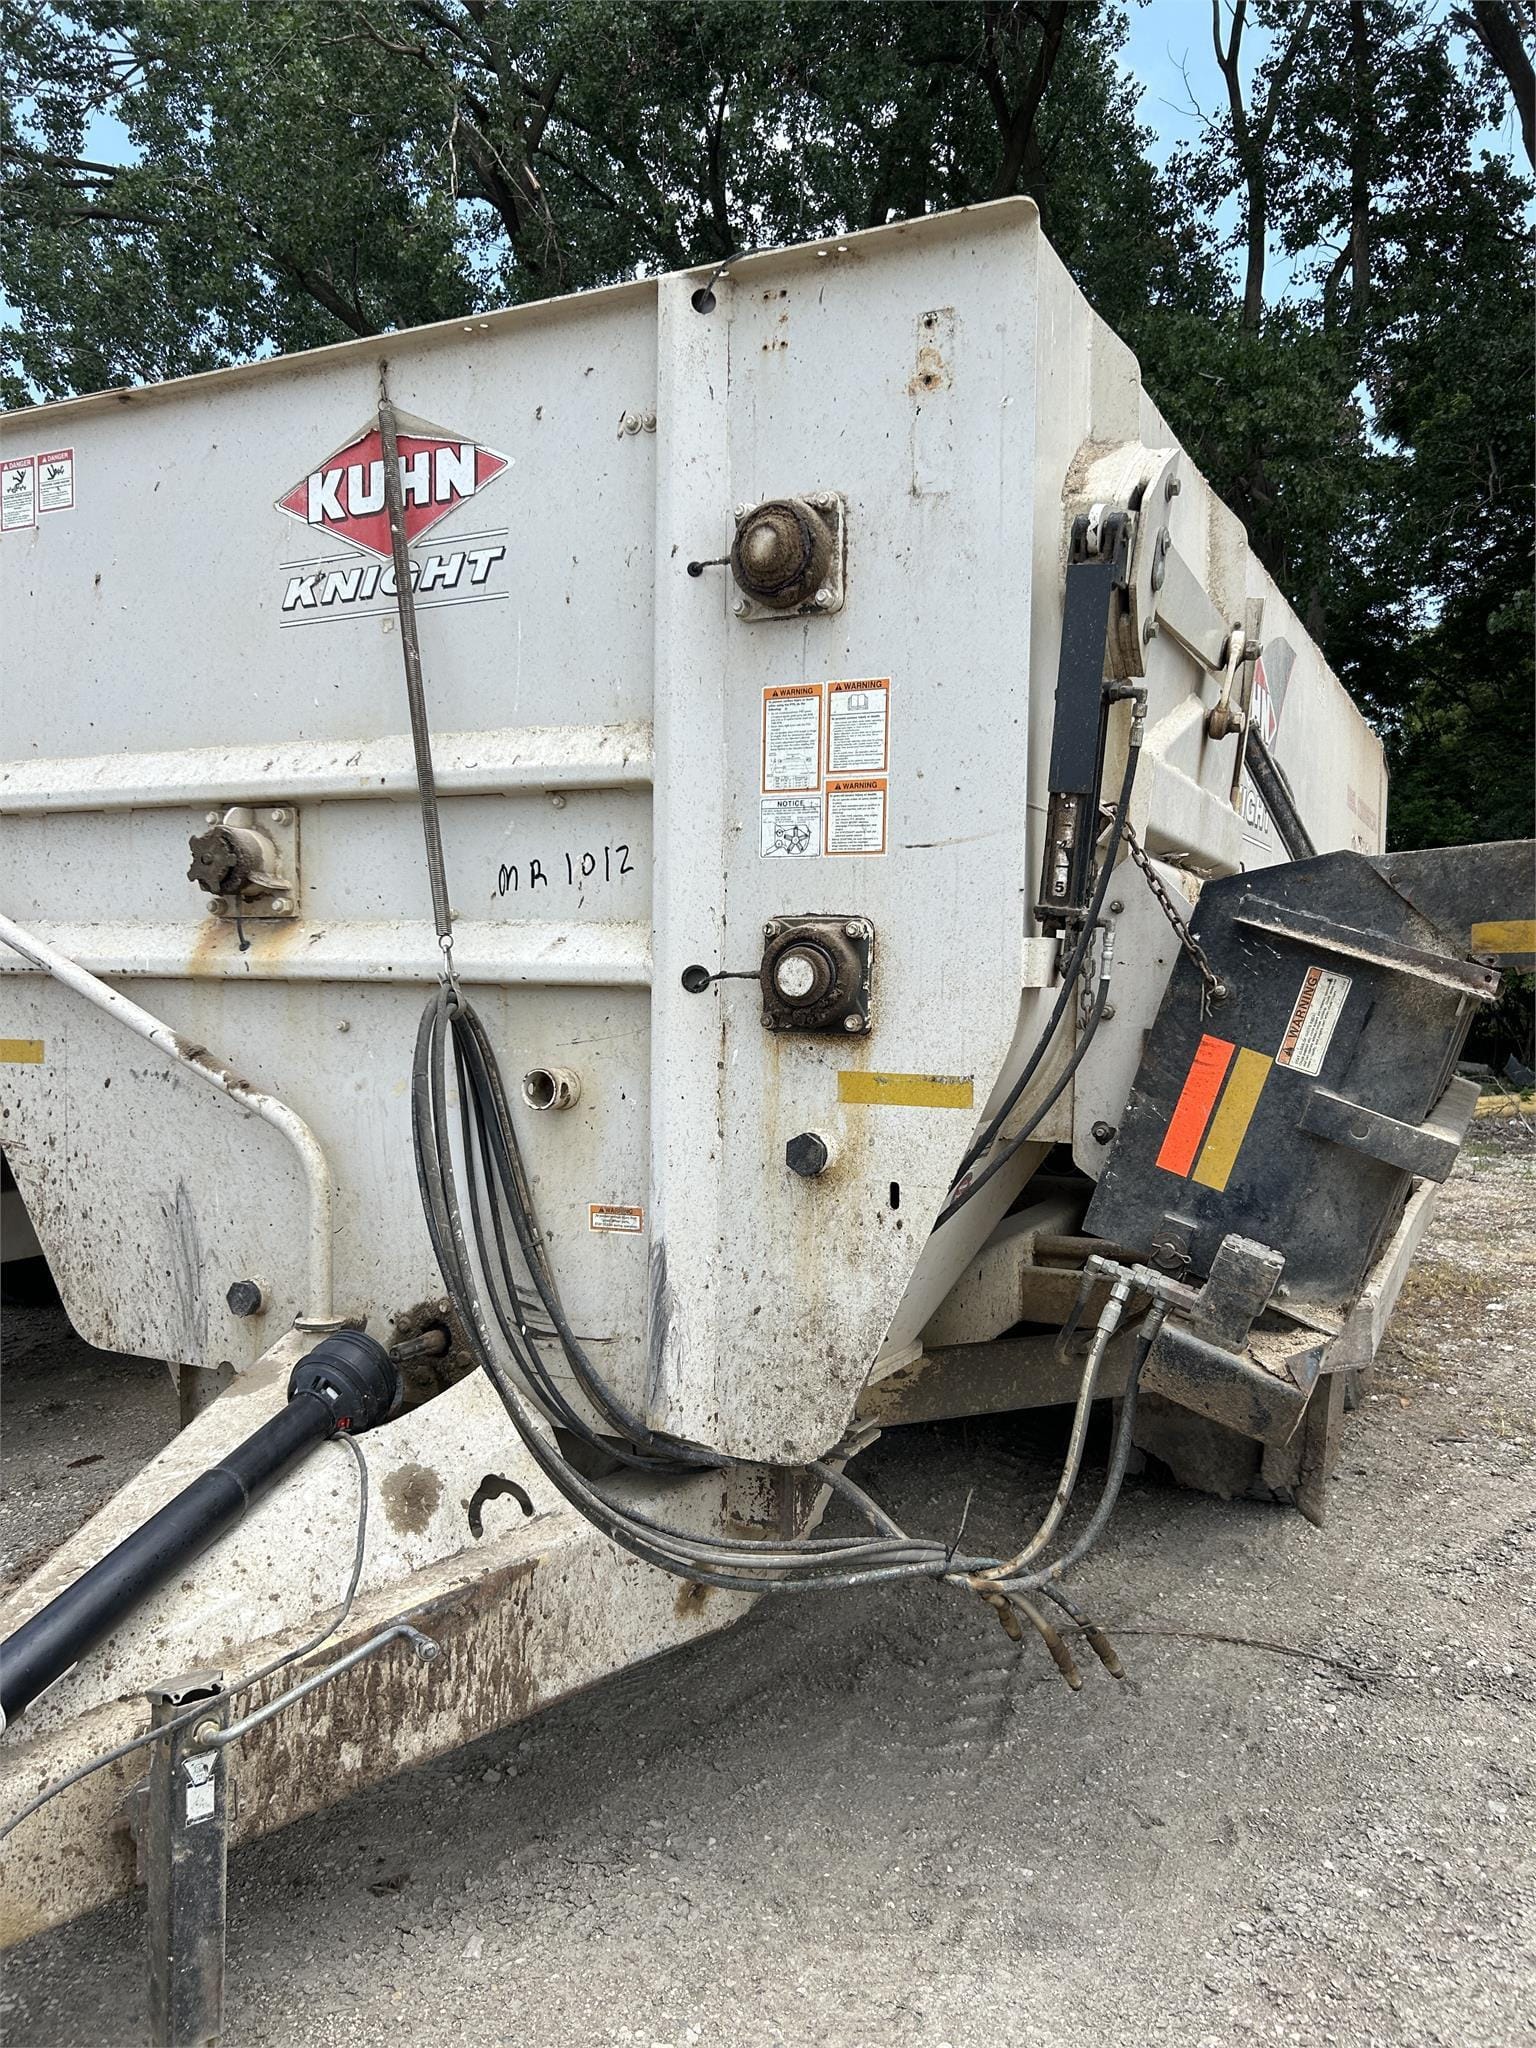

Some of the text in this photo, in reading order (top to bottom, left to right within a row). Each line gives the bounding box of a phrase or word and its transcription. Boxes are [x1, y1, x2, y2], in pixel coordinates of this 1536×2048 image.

[47, 452, 69, 463] DANGER
[9, 459, 31, 470] DANGER
[307, 443, 476, 525] KUHN
[281, 545, 507, 611] KNIGHT
[843, 680, 882, 691] WARNING
[780, 687, 813, 697] WARNING
[842, 781, 878, 790] WARNING
[777, 800, 804, 808] NOTICE
[565, 845, 635, 885] 1012
[1055, 881, 1065, 893] 5
[1288, 977, 1318, 1038] WARNING
